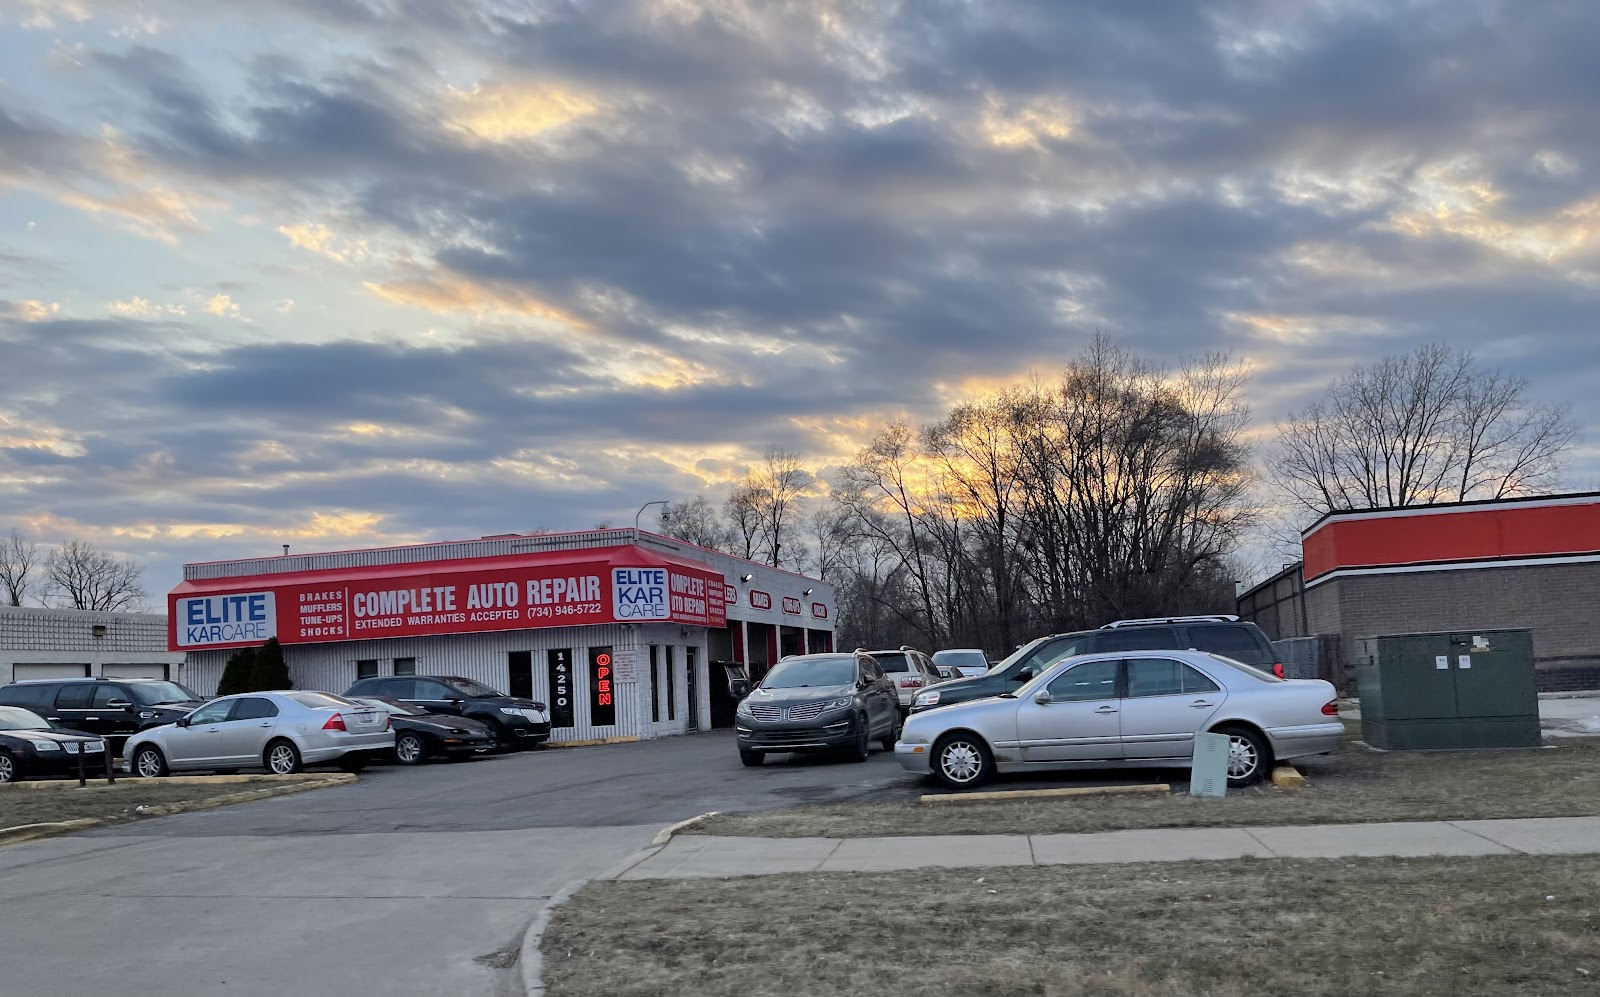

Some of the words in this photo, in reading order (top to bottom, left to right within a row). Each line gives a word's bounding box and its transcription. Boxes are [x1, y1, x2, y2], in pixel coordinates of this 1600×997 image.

[616, 570, 664, 585] ELITE
[300, 591, 342, 602] BRAKES
[353, 585, 457, 618] COMPLETE
[467, 581, 519, 610] AUTO
[526, 575, 601, 606] REPAIR
[618, 587, 663, 604] KAR
[187, 594, 266, 626] ELITE
[300, 603, 343, 613] MUFFLERS
[618, 603, 665, 618] CARE
[684, 596, 706, 615] REPAIR
[300, 614, 343, 625] TUNE-UPS
[355, 617, 403, 630] EXTENDED
[407, 613, 466, 626] WARRANTIES
[470, 609, 519, 622] ACCEPTED
[527, 606, 553, 620] (734)
[555, 603, 602, 615] 946-5722
[300, 626, 343, 637] SHOCKS
[556, 652, 567, 706] 14250
[596, 653, 611, 706] OPEN
